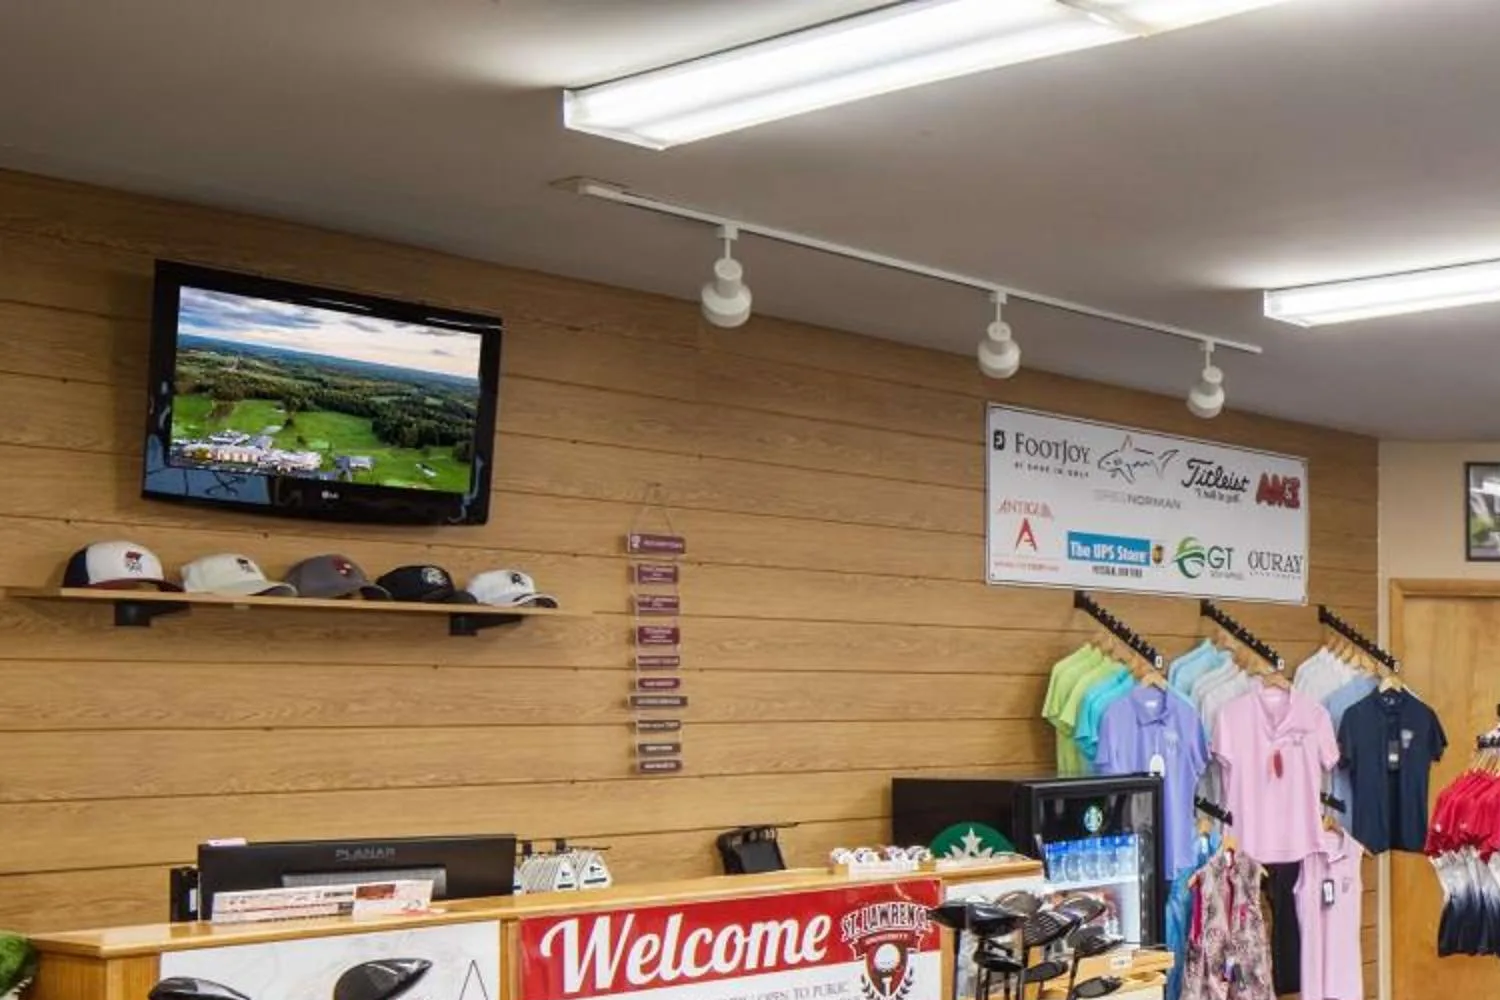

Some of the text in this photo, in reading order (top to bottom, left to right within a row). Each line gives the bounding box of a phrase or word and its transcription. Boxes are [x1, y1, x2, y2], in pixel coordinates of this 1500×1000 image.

[1182, 457, 1250, 492] Titleist
[1070, 541, 1146, 563] The UPS Store
[1207, 545, 1234, 570] GT
[1247, 550, 1304, 574] OURAY
[539, 910, 831, 993] Welcome
[793, 988, 810, 1000] TO
